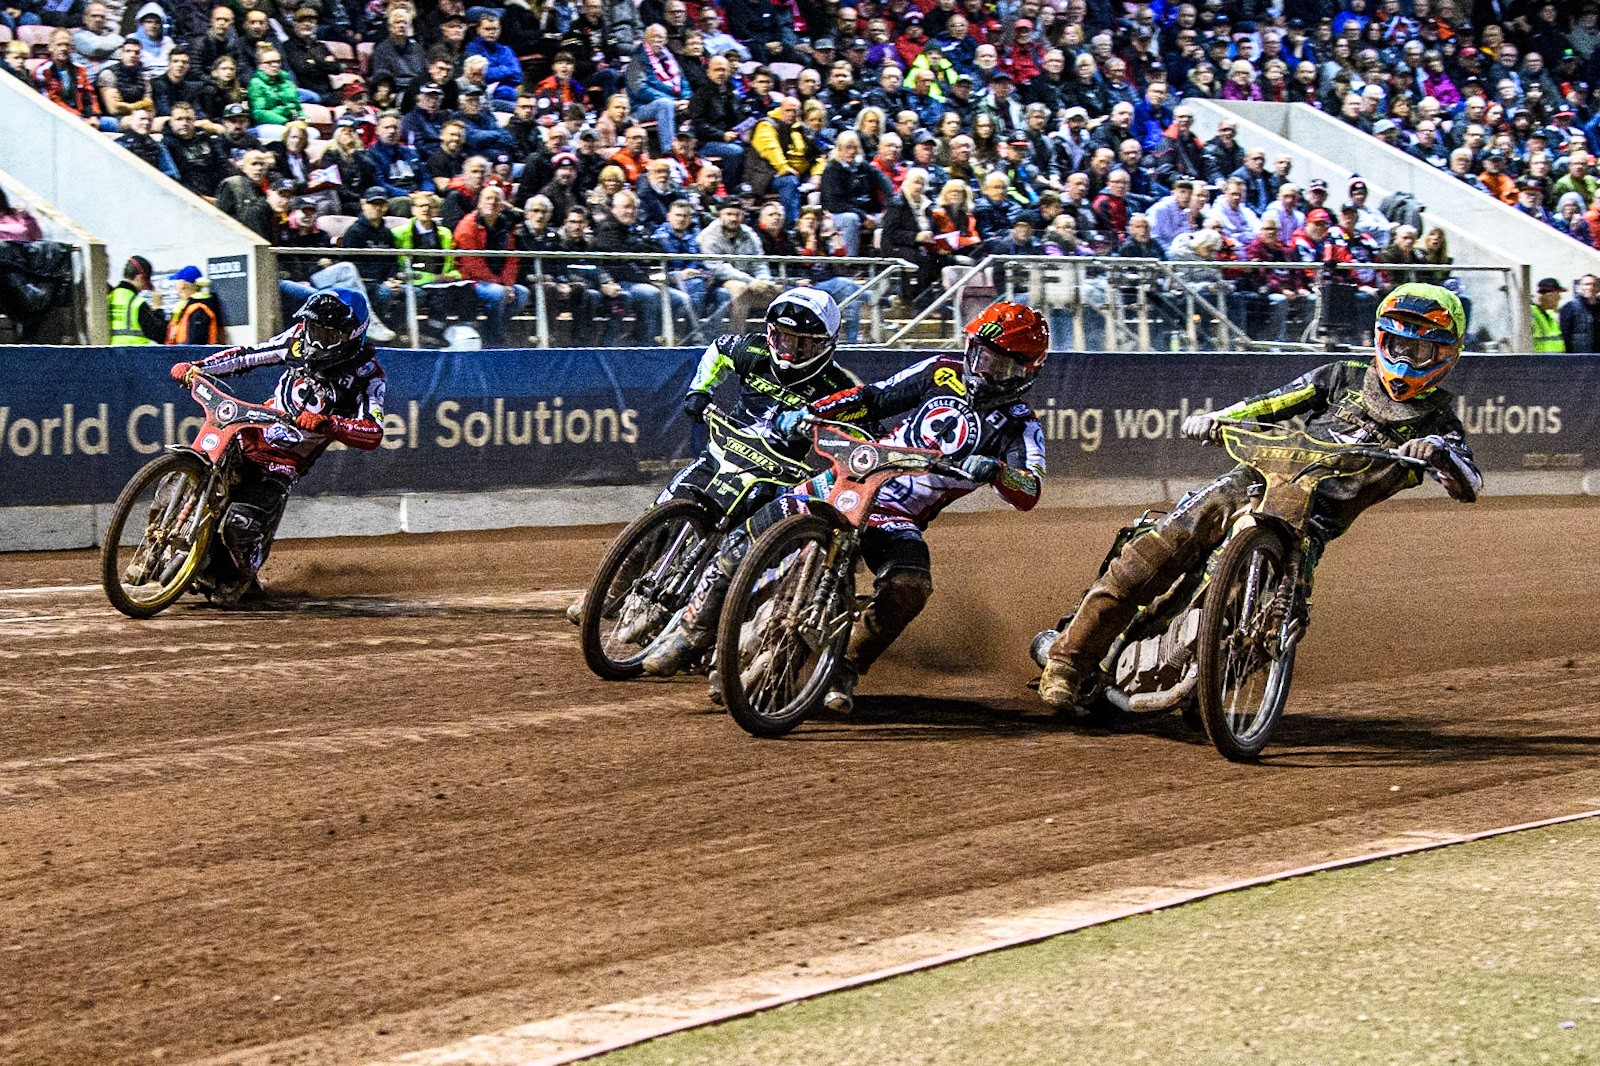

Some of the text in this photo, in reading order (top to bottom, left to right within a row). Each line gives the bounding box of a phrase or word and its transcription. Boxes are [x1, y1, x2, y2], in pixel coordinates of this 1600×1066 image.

[436, 397, 638, 448] Solutions
[928, 400, 956, 411] BELLE
[1456, 395, 1563, 435] lutions
[0, 402, 206, 457] orld Cla
